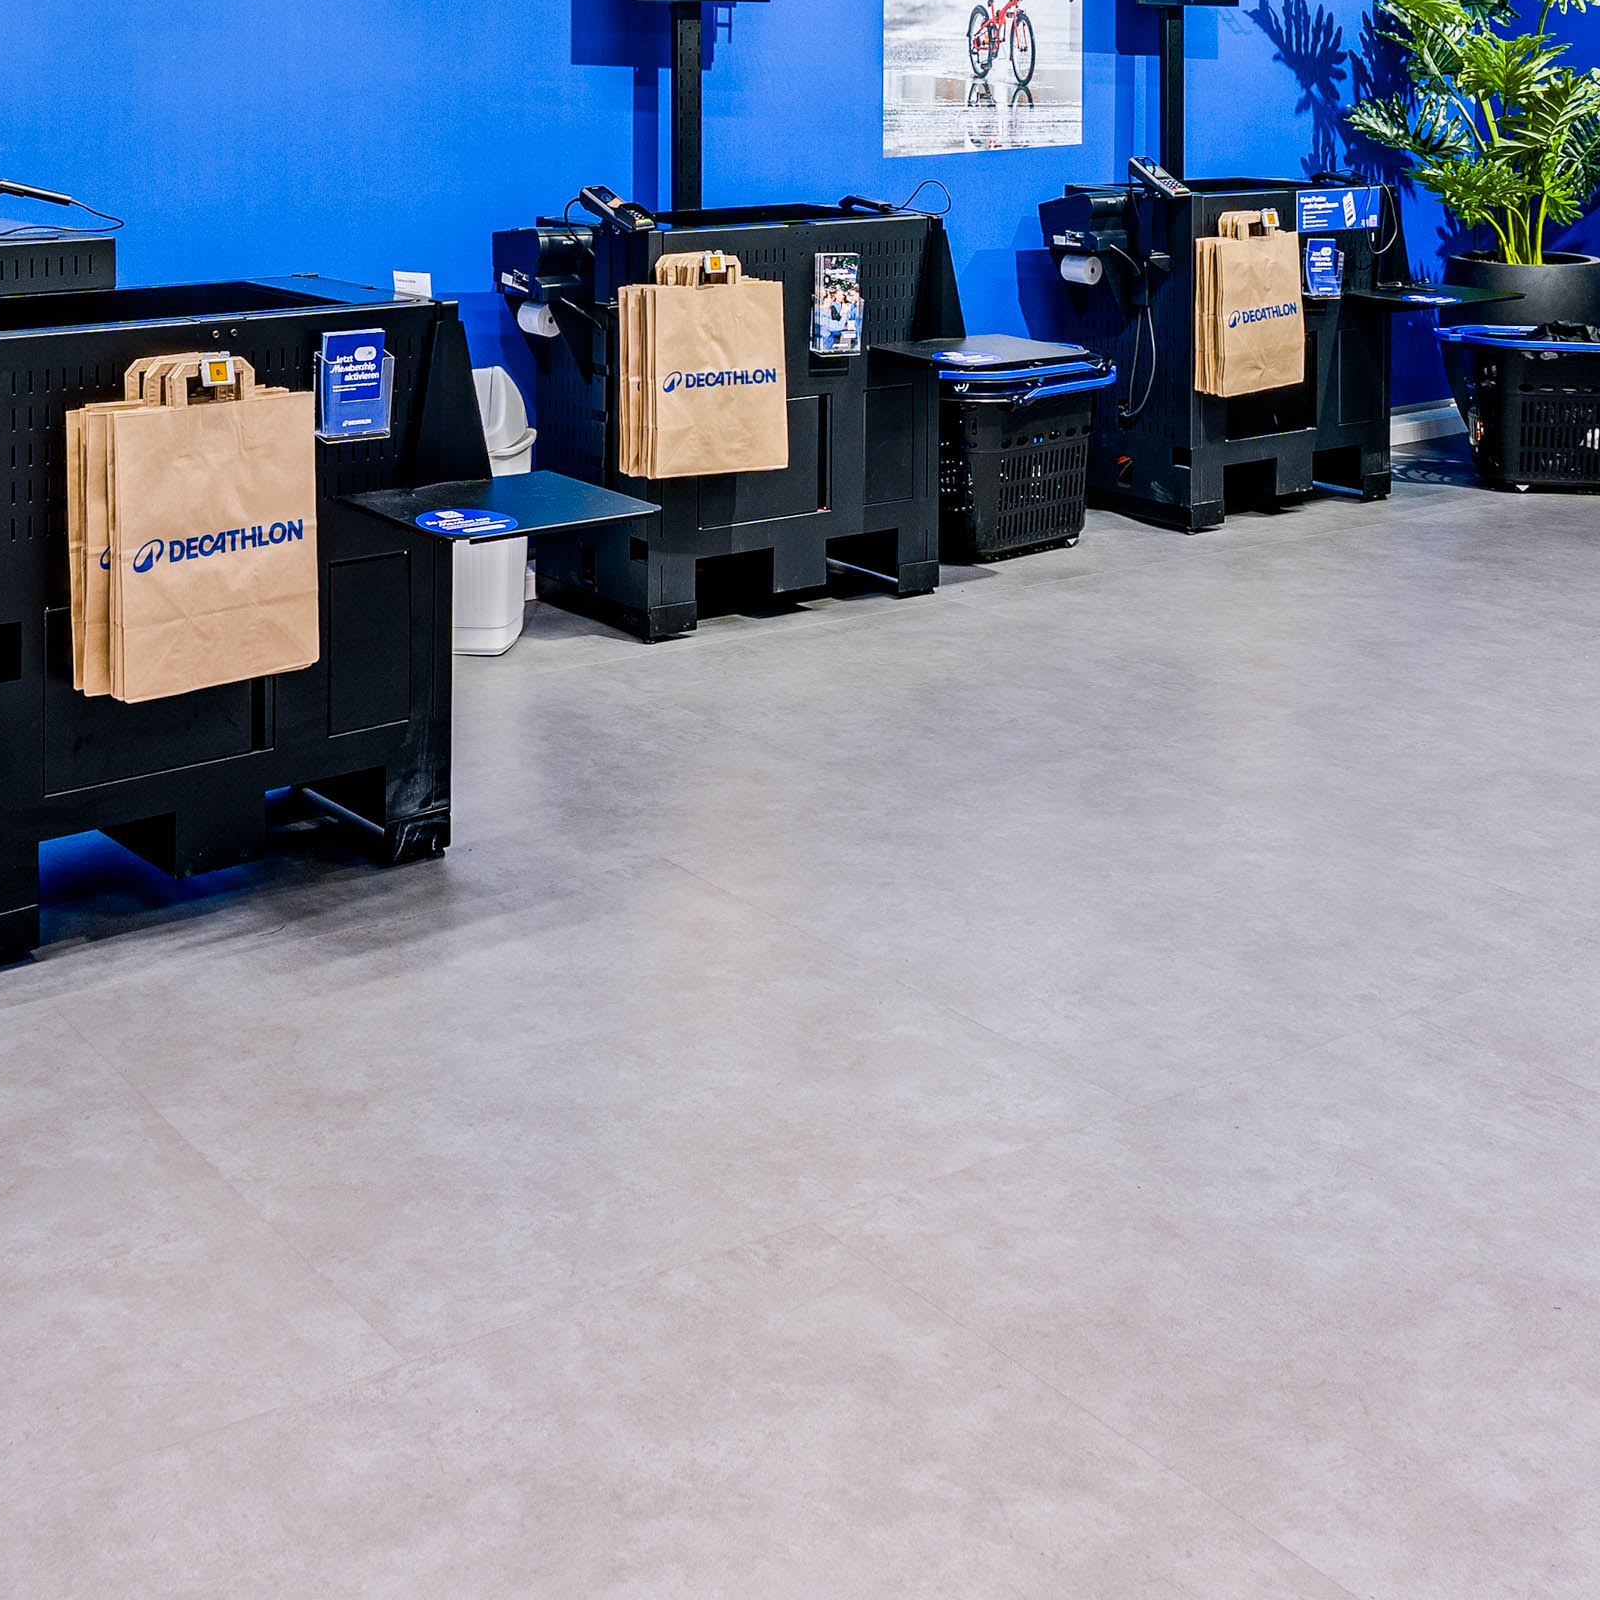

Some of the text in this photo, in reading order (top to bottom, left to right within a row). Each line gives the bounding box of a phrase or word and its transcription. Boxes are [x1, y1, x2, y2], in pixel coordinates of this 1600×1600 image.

[1242, 302, 1297, 324] DECATHLON
[685, 368, 777, 389] DECATHLON
[169, 519, 303, 563] DECATHLON
